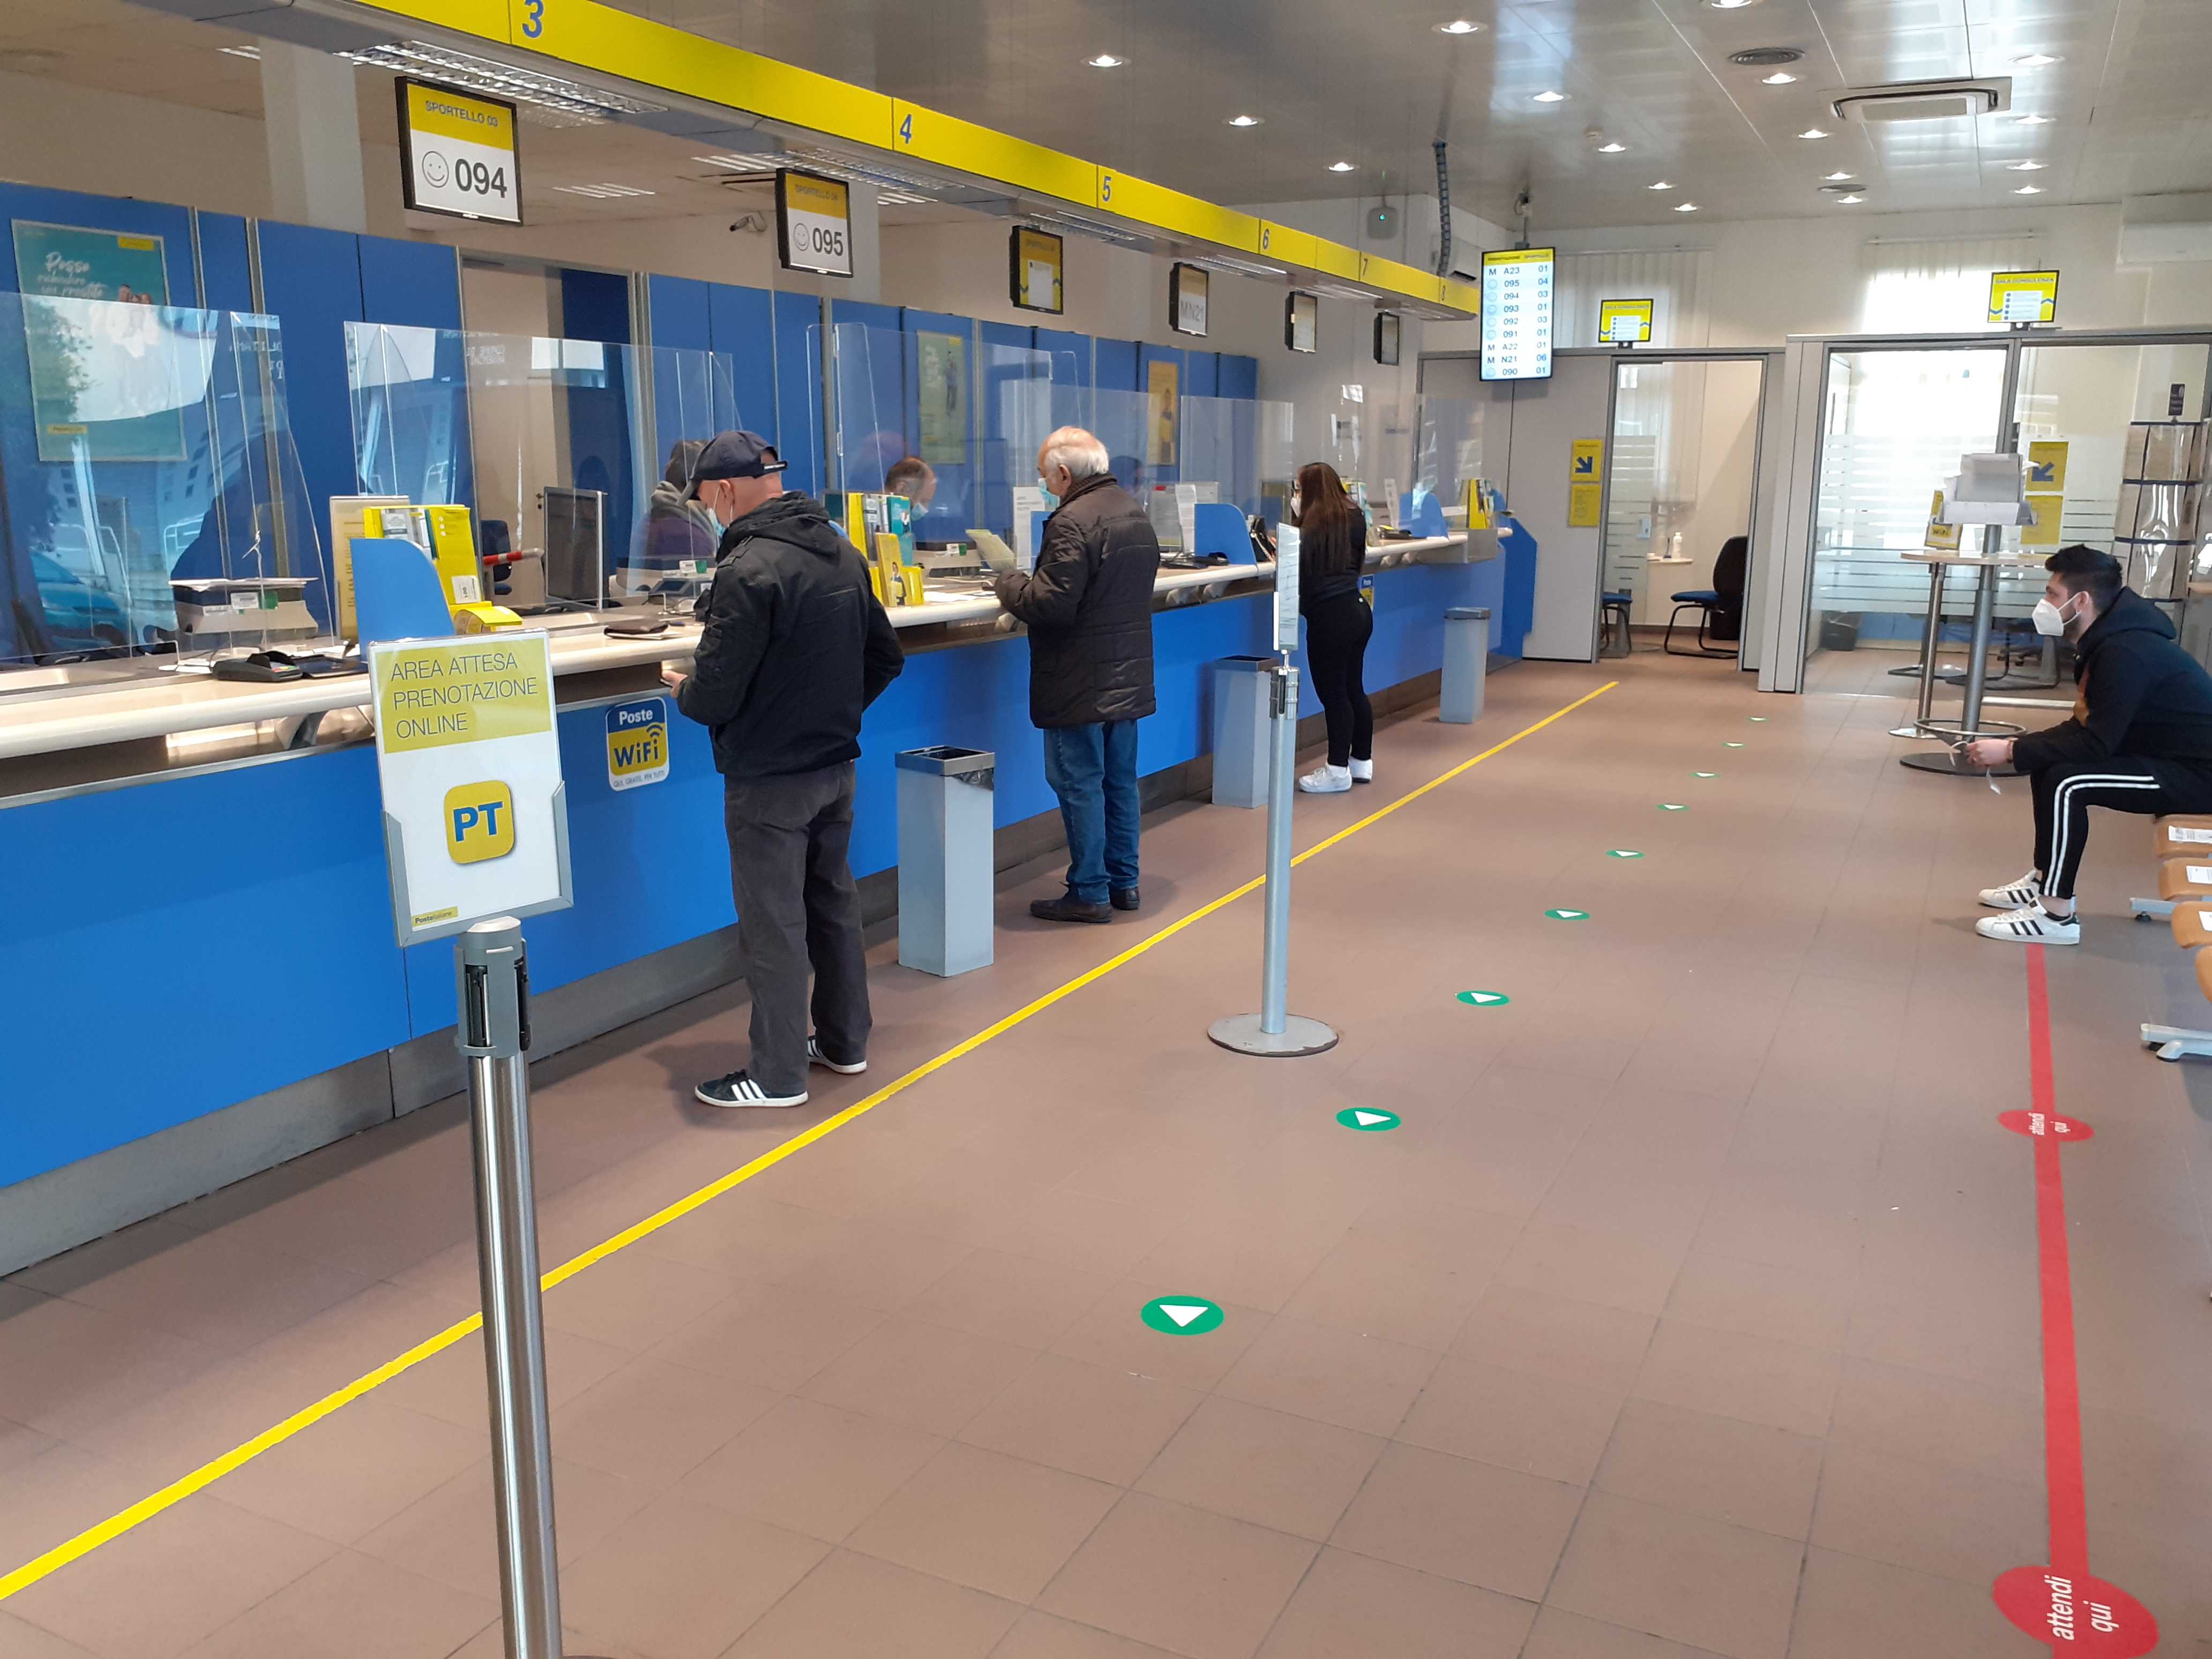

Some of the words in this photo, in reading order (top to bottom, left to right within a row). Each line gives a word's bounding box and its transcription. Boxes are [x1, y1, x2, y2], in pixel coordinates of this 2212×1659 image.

[522, 0, 544, 38] 3
[425, 100, 484, 123] SPORTELLO
[488, 115, 498, 127] 03
[900, 114, 911, 144] 4
[455, 158, 507, 198] 094
[1103, 176, 1111, 201] 5
[812, 228, 843, 256] 095
[1262, 228, 1269, 250] 6
[1362, 258, 1369, 276] 7
[1504, 267, 1520, 275] A23
[1504, 279, 1520, 287] 095
[1538, 278, 1548, 286] 04
[1504, 305, 1519, 313] 093
[391, 660, 444, 682] AREA
[449, 652, 518, 675] ATTESA
[394, 677, 538, 710] PRENOTAZIONE
[397, 712, 468, 739] ONLINE
[619, 709, 653, 726] Poste
[614, 738, 659, 767] WiFi
[453, 801, 503, 842] PT
[2028, 1112, 2045, 1135] attendi
[2050, 1120, 2071, 1133] qui
[2044, 1574, 2075, 1640] attendi
[2083, 1600, 2119, 1632] qui
